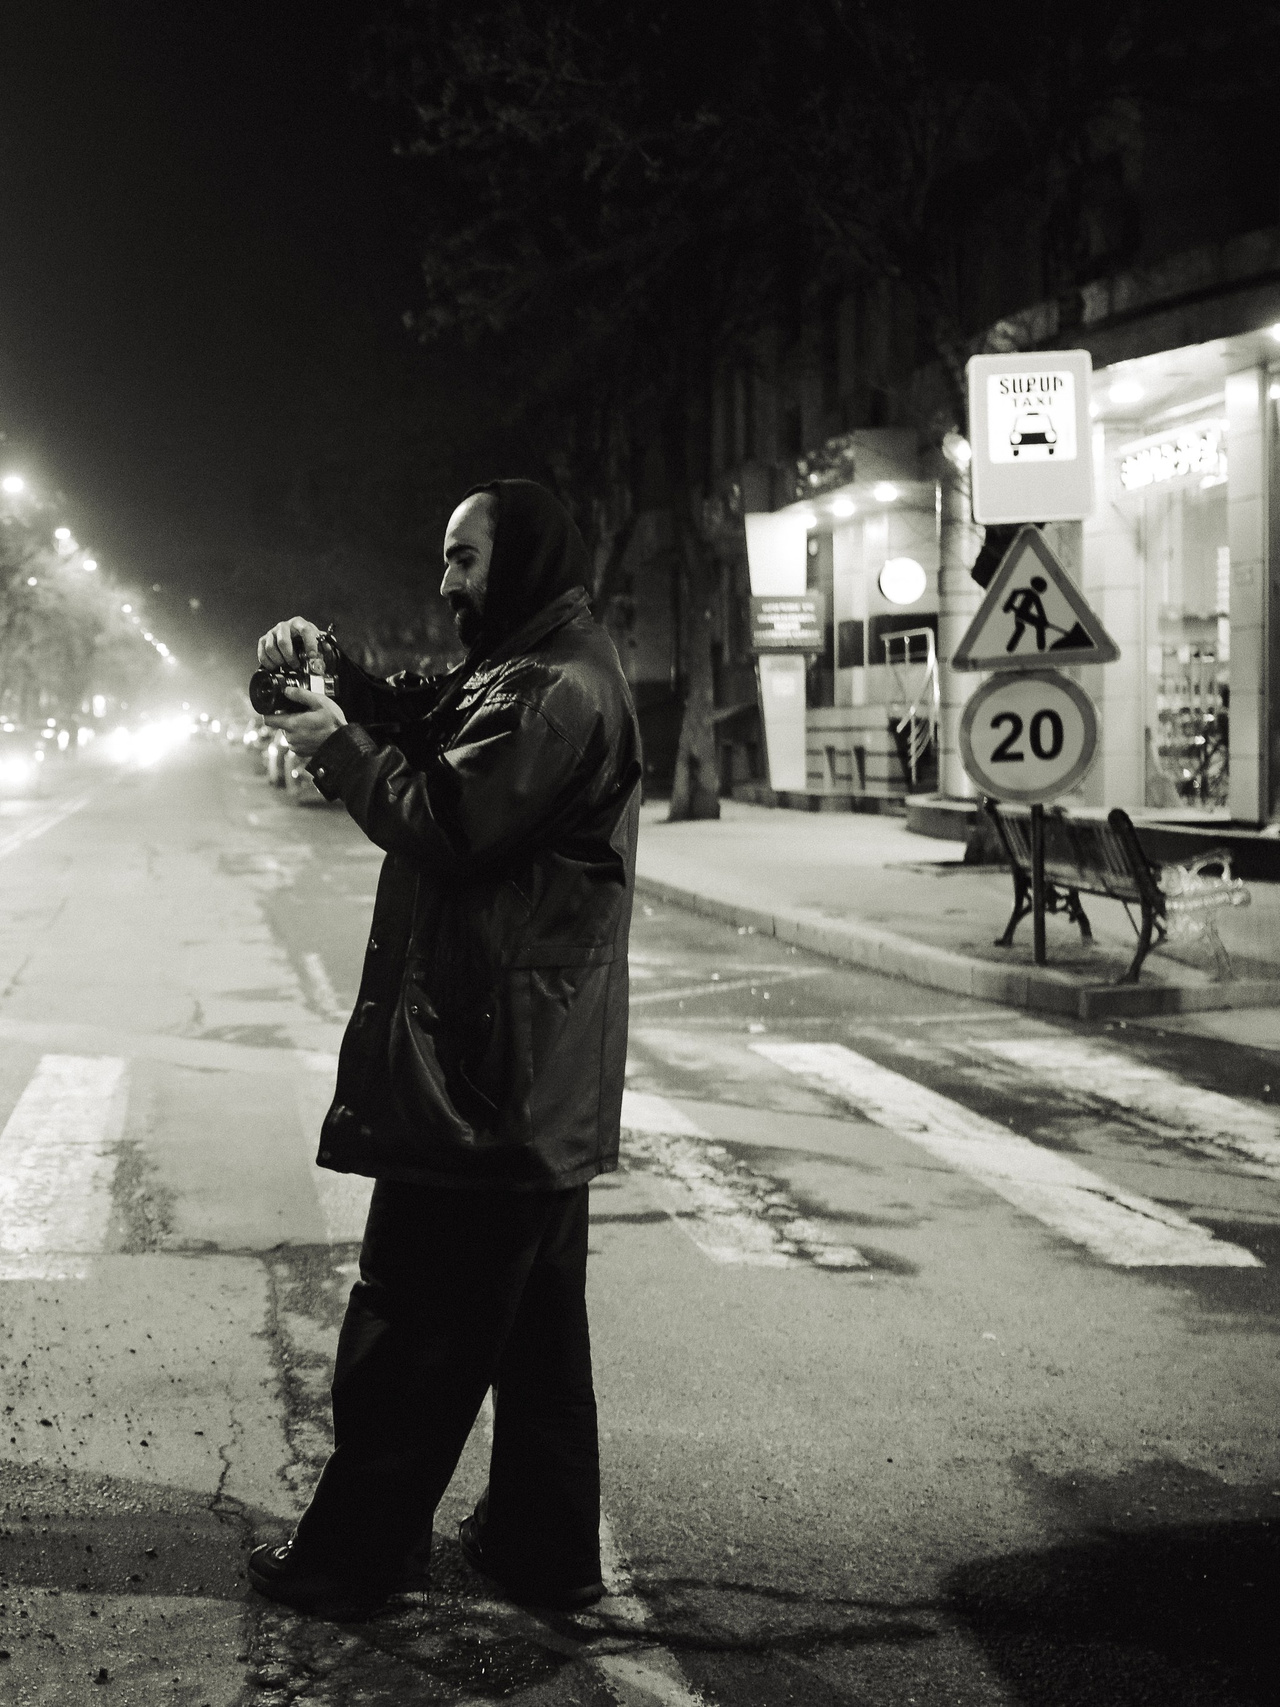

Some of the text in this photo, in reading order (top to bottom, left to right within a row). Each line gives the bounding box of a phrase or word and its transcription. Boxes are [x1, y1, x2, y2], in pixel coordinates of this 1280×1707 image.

[999, 376, 1063, 395] ՏԱՔՍԻ
[1012, 396, 1052, 407] TAXI
[990, 709, 1064, 763] 20
